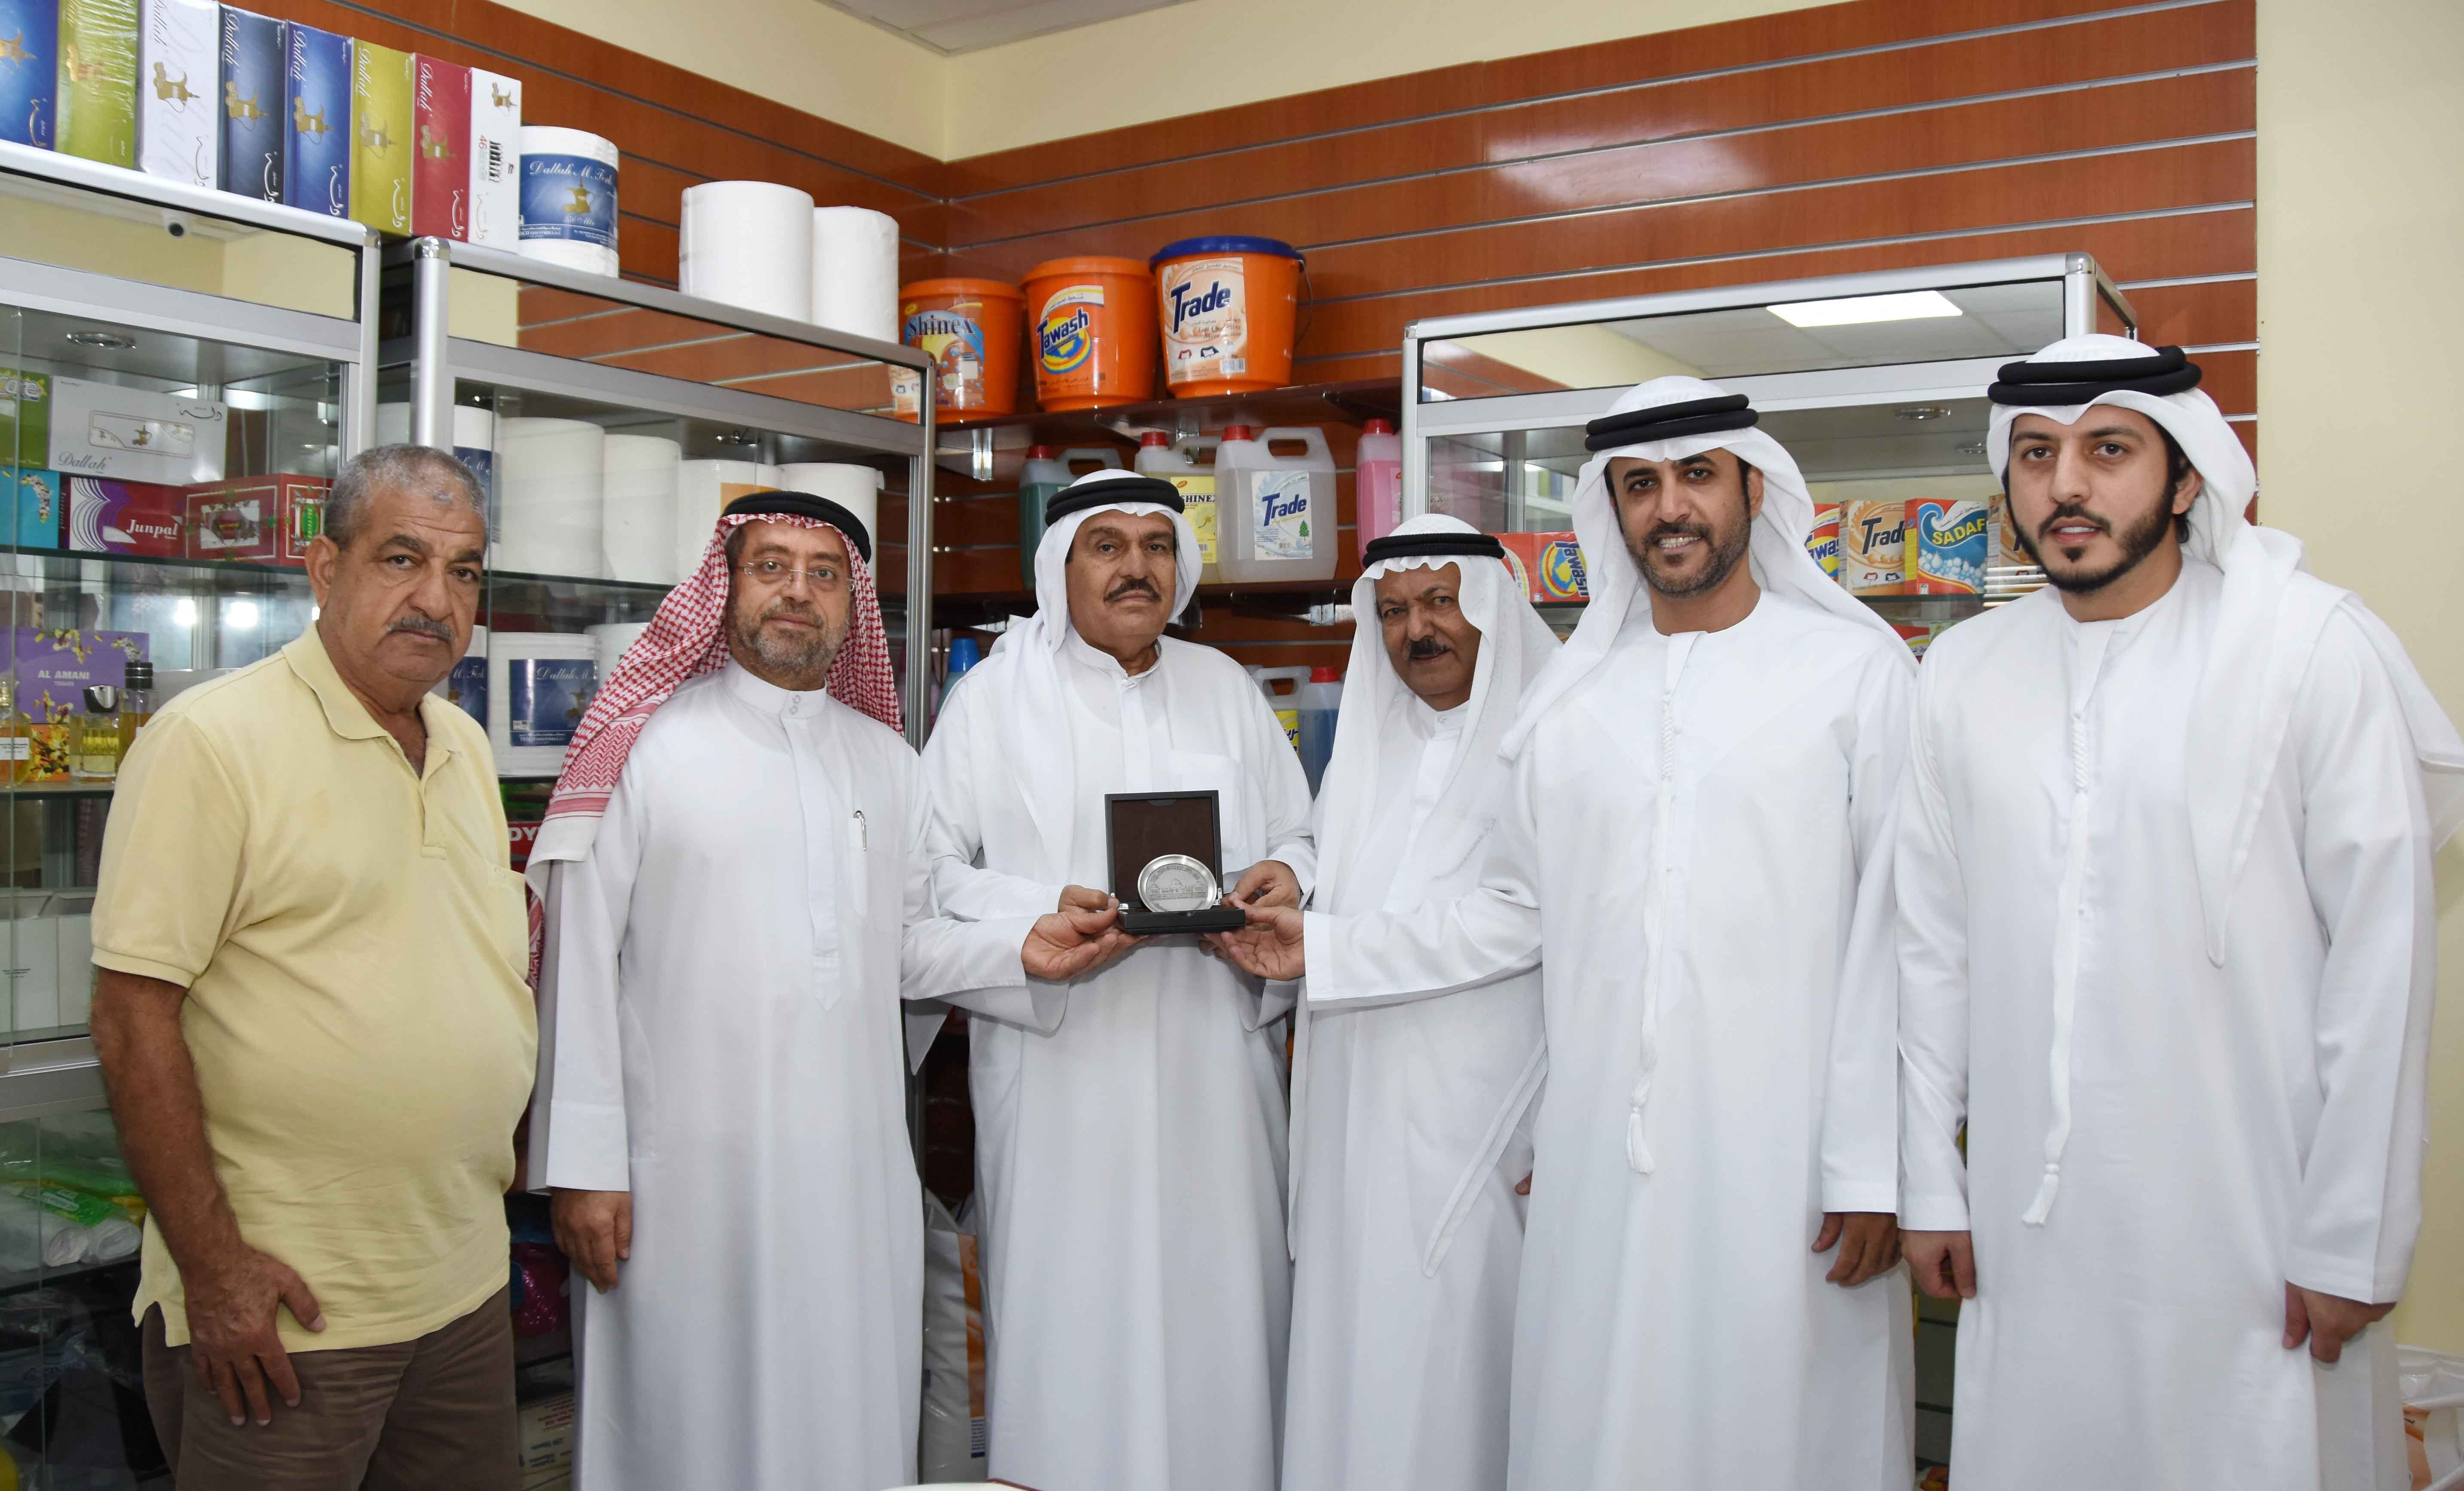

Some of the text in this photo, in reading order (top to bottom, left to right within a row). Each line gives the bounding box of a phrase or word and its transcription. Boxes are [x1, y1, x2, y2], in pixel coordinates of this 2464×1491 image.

[222, 13, 239, 66] Dallah
[291, 30, 307, 81] Dallah
[359, 48, 372, 97] Dallah
[419, 62, 433, 110] Dallah
[478, 134, 487, 149] 46
[530, 161, 572, 175] Dallah
[1171, 280, 1231, 334] Trade
[908, 313, 974, 337] Shinex
[1037, 307, 1088, 360] Tawash
[59, 451, 106, 470] Dallah
[1262, 493, 1307, 527] Trade
[126, 519, 179, 539] Junpal
[1932, 518, 1986, 545] SADAF
[1805, 534, 1839, 560] awa
[37, 669, 89, 680] AL AMANI
[536, 666, 575, 680] Dallah
